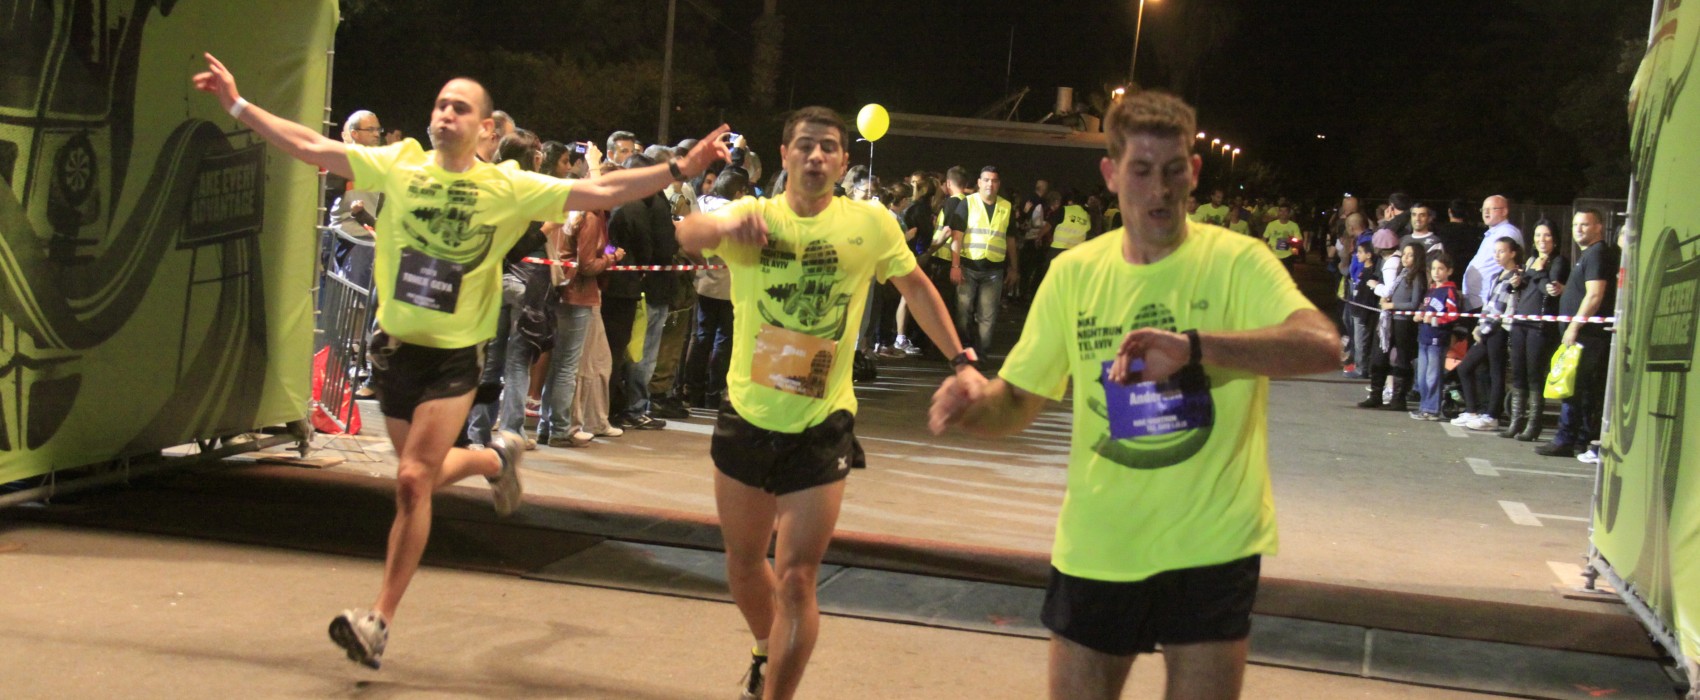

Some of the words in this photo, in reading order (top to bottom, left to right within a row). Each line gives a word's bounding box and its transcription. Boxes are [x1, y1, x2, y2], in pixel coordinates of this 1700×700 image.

[198, 169, 221, 195] AKE
[222, 161, 257, 194] EVERY
[770, 259, 789, 270] AVIV
[1077, 326, 1123, 339] NIGHTRUN
[1078, 340, 1093, 352] TEL
[1094, 338, 1113, 350] AVIV
